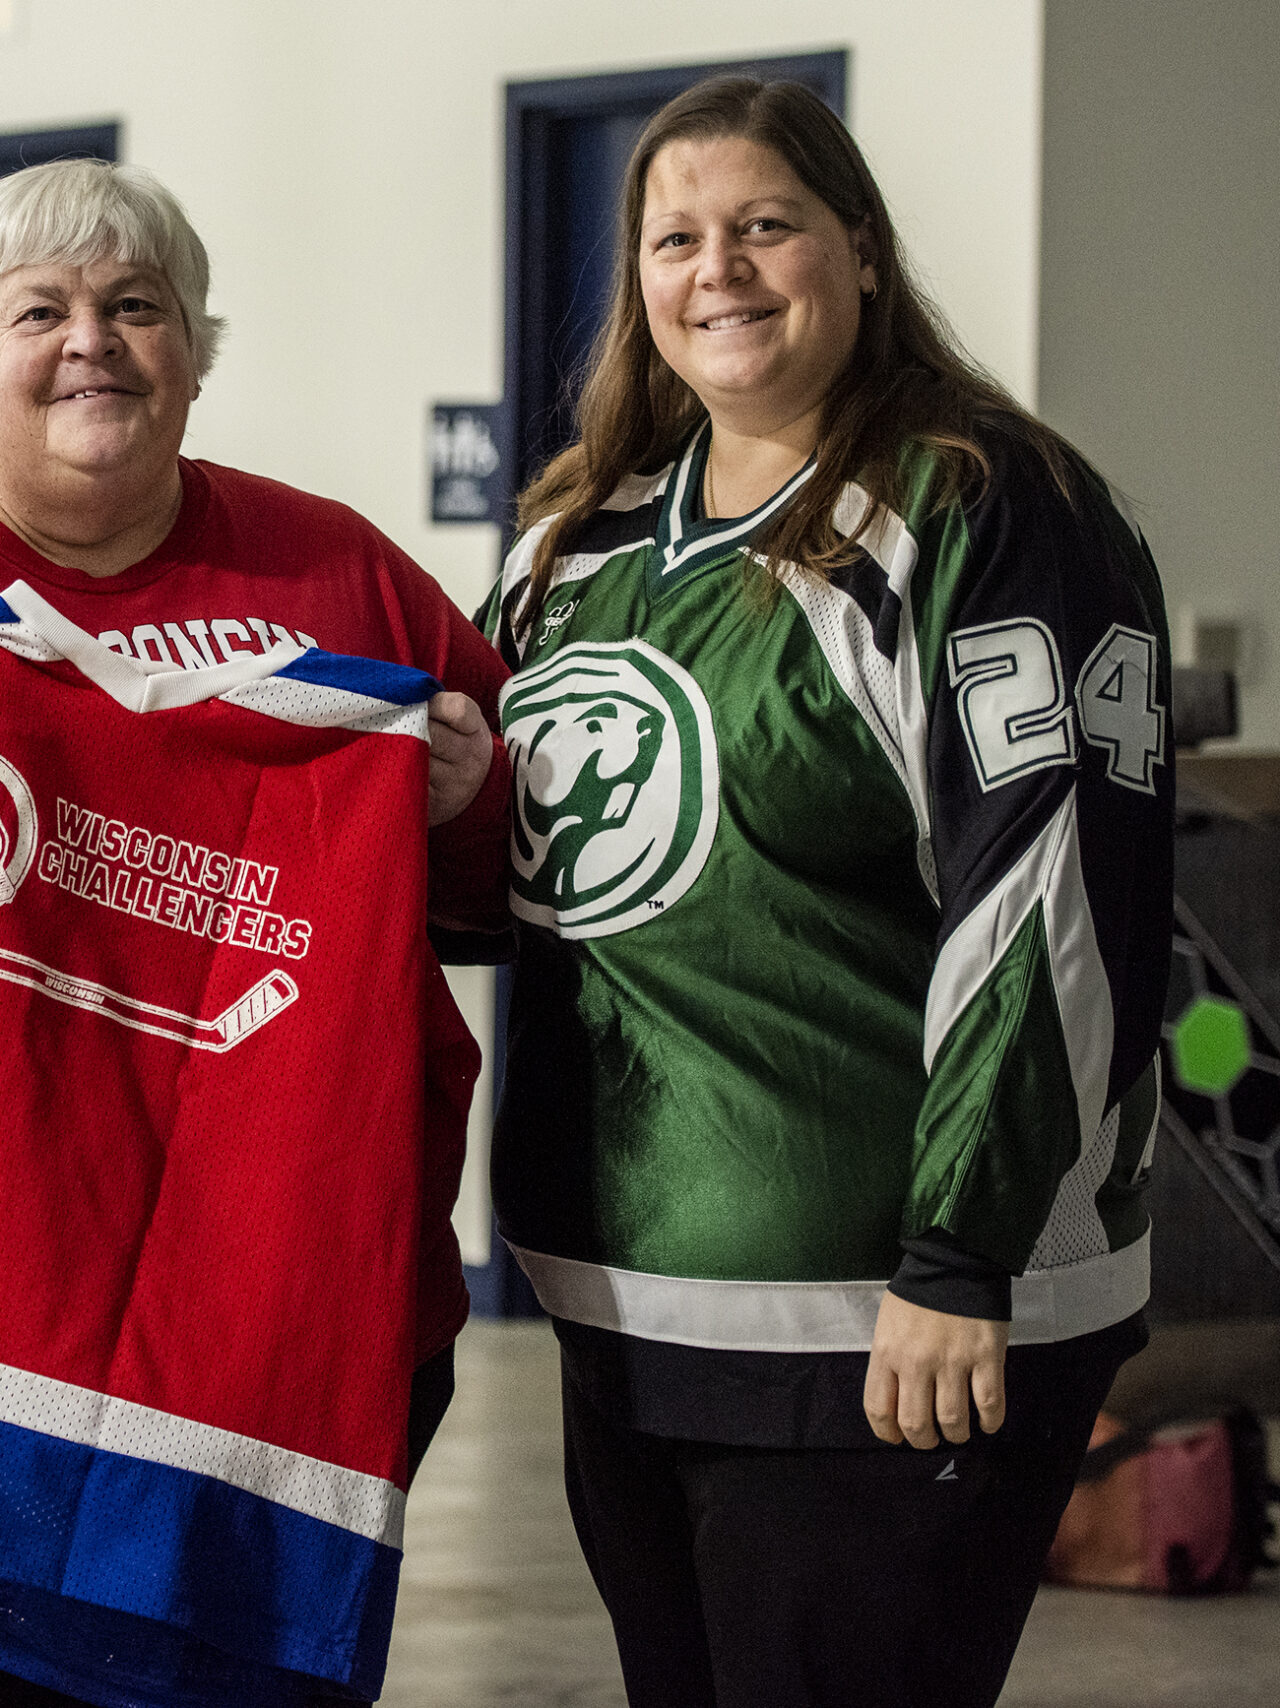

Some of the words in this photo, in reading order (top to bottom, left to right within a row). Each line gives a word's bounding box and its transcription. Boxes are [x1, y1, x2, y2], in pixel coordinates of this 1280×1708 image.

[946, 616, 1166, 797] 24
[38, 840, 313, 960] CHALLENGERS
[56, 796, 279, 907] WISCONSIN
[646, 900, 665, 910] TM
[44, 975, 105, 1004] WISCONSIN
